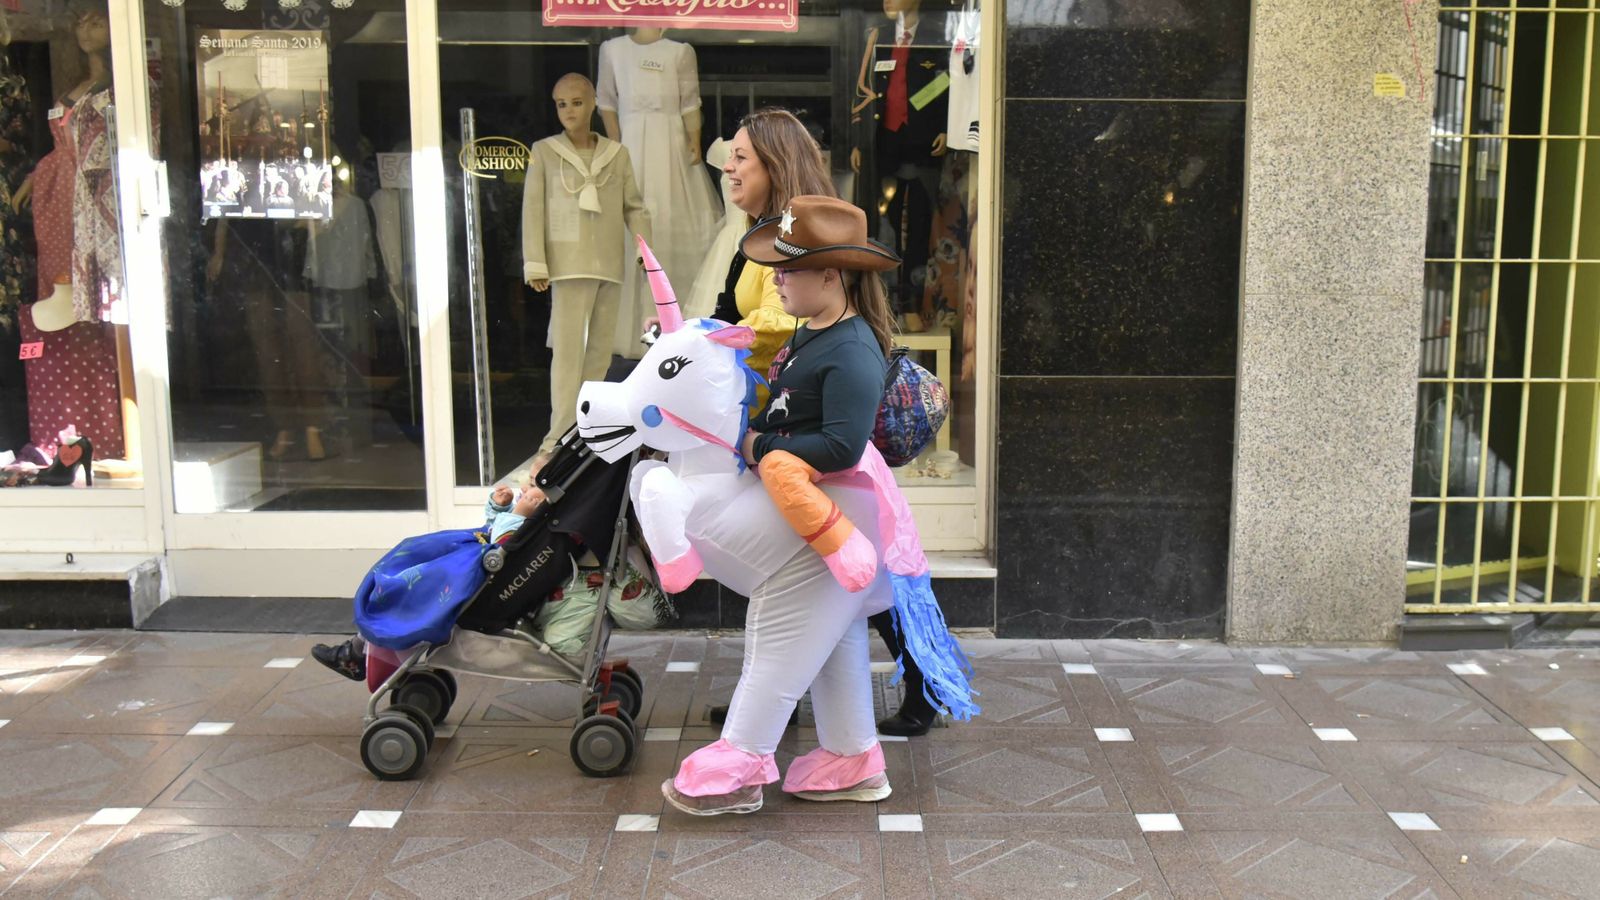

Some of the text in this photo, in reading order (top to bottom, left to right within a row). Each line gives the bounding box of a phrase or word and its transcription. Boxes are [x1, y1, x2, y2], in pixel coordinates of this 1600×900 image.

[199, 35, 321, 49] Semana Santa 2019
[467, 146, 525, 157] OMERCIO
[467, 158, 525, 170] ASHION
[499, 546, 554, 601] MACLAREN
